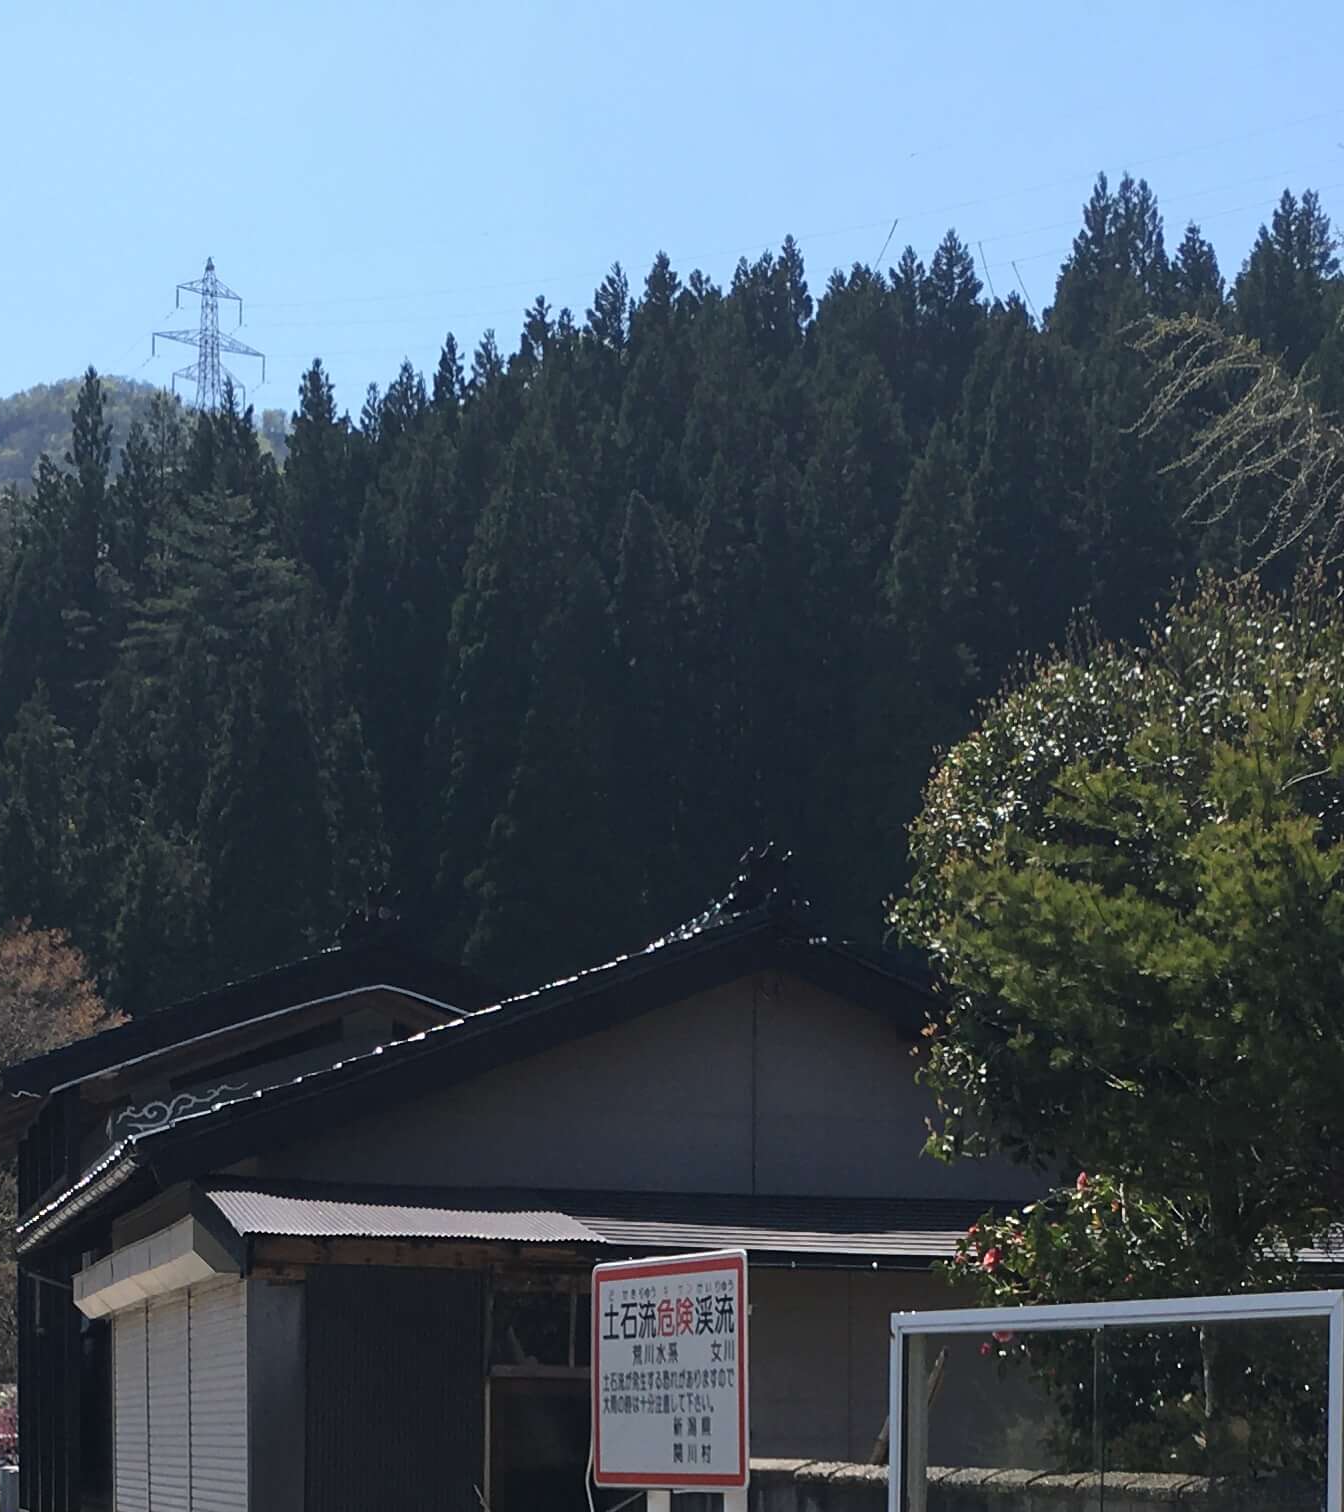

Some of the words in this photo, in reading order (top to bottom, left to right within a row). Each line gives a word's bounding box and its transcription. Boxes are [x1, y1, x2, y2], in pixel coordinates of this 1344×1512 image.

[603, 1294, 735, 1340] 土石流危険渓流
[710, 1339, 735, 1362] 女川
